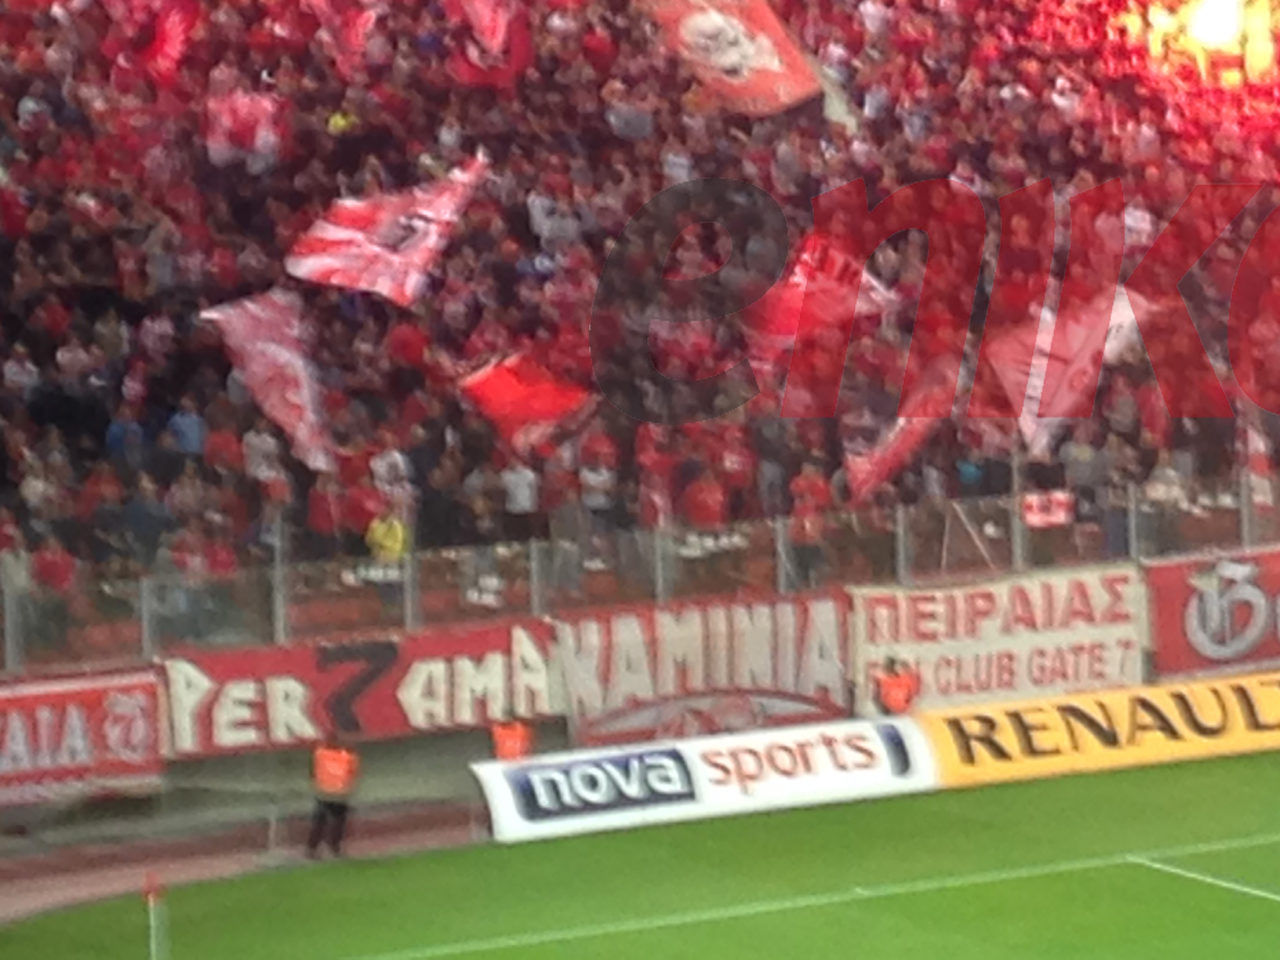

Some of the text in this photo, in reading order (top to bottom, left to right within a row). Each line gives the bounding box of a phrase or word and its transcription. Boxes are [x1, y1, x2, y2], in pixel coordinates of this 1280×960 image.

[865, 574, 1133, 642] ΠΕΙΡΑΙΑΣ
[556, 597, 848, 725] KAMINIA
[934, 649, 1016, 695] CLUB
[1028, 641, 1107, 687] GATE
[1115, 638, 1136, 683] 7
[528, 728, 880, 812] nova sports
